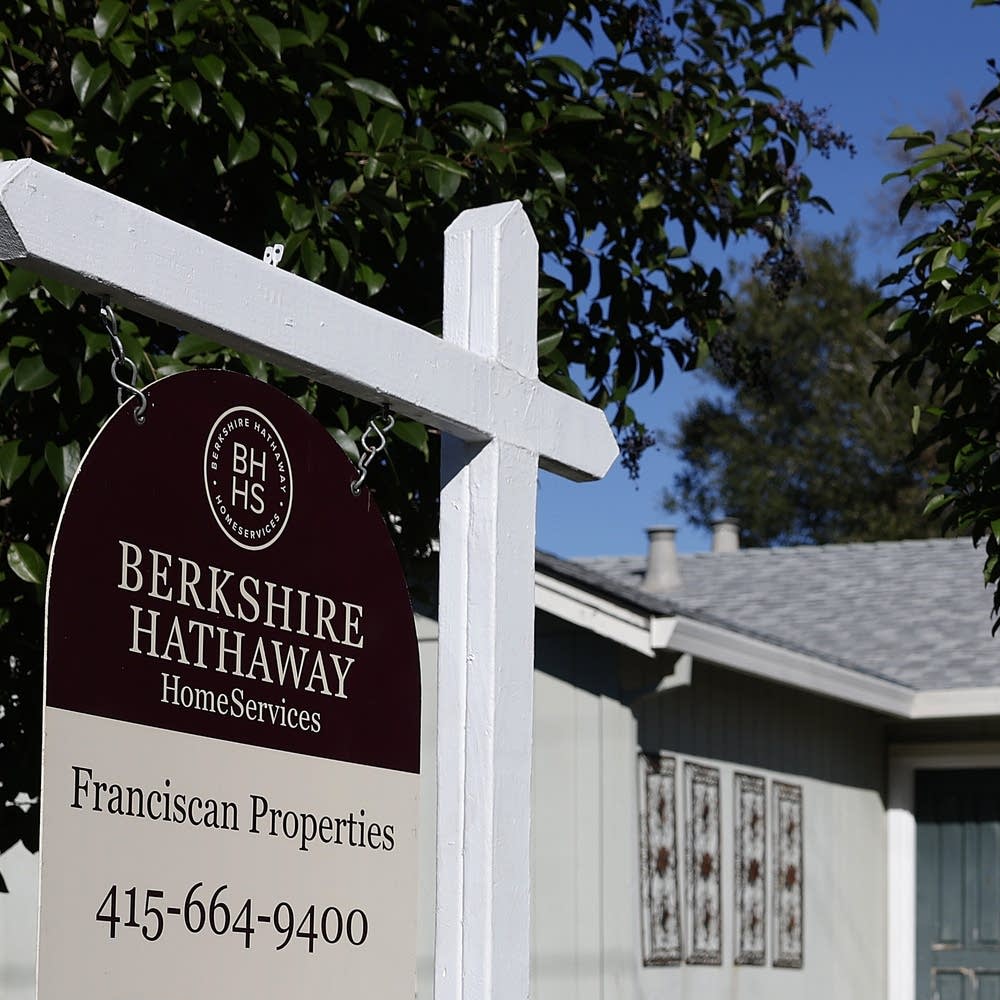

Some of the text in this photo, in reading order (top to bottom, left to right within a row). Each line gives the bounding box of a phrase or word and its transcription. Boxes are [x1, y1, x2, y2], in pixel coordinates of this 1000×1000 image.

[211, 418, 286, 493] BERKSHIRE HATHAWAY
[233, 441, 267, 482] BH
[215, 494, 280, 539] HOMESERVICES
[232, 475, 265, 514] HS
[117, 540, 364, 649] BERKSHIRE
[129, 605, 355, 699] HATHAWAY
[160, 672, 321, 733] HomeServices
[70, 765, 395, 851] Franciscan Properties
[96, 881, 368, 953] 415-664-9400
